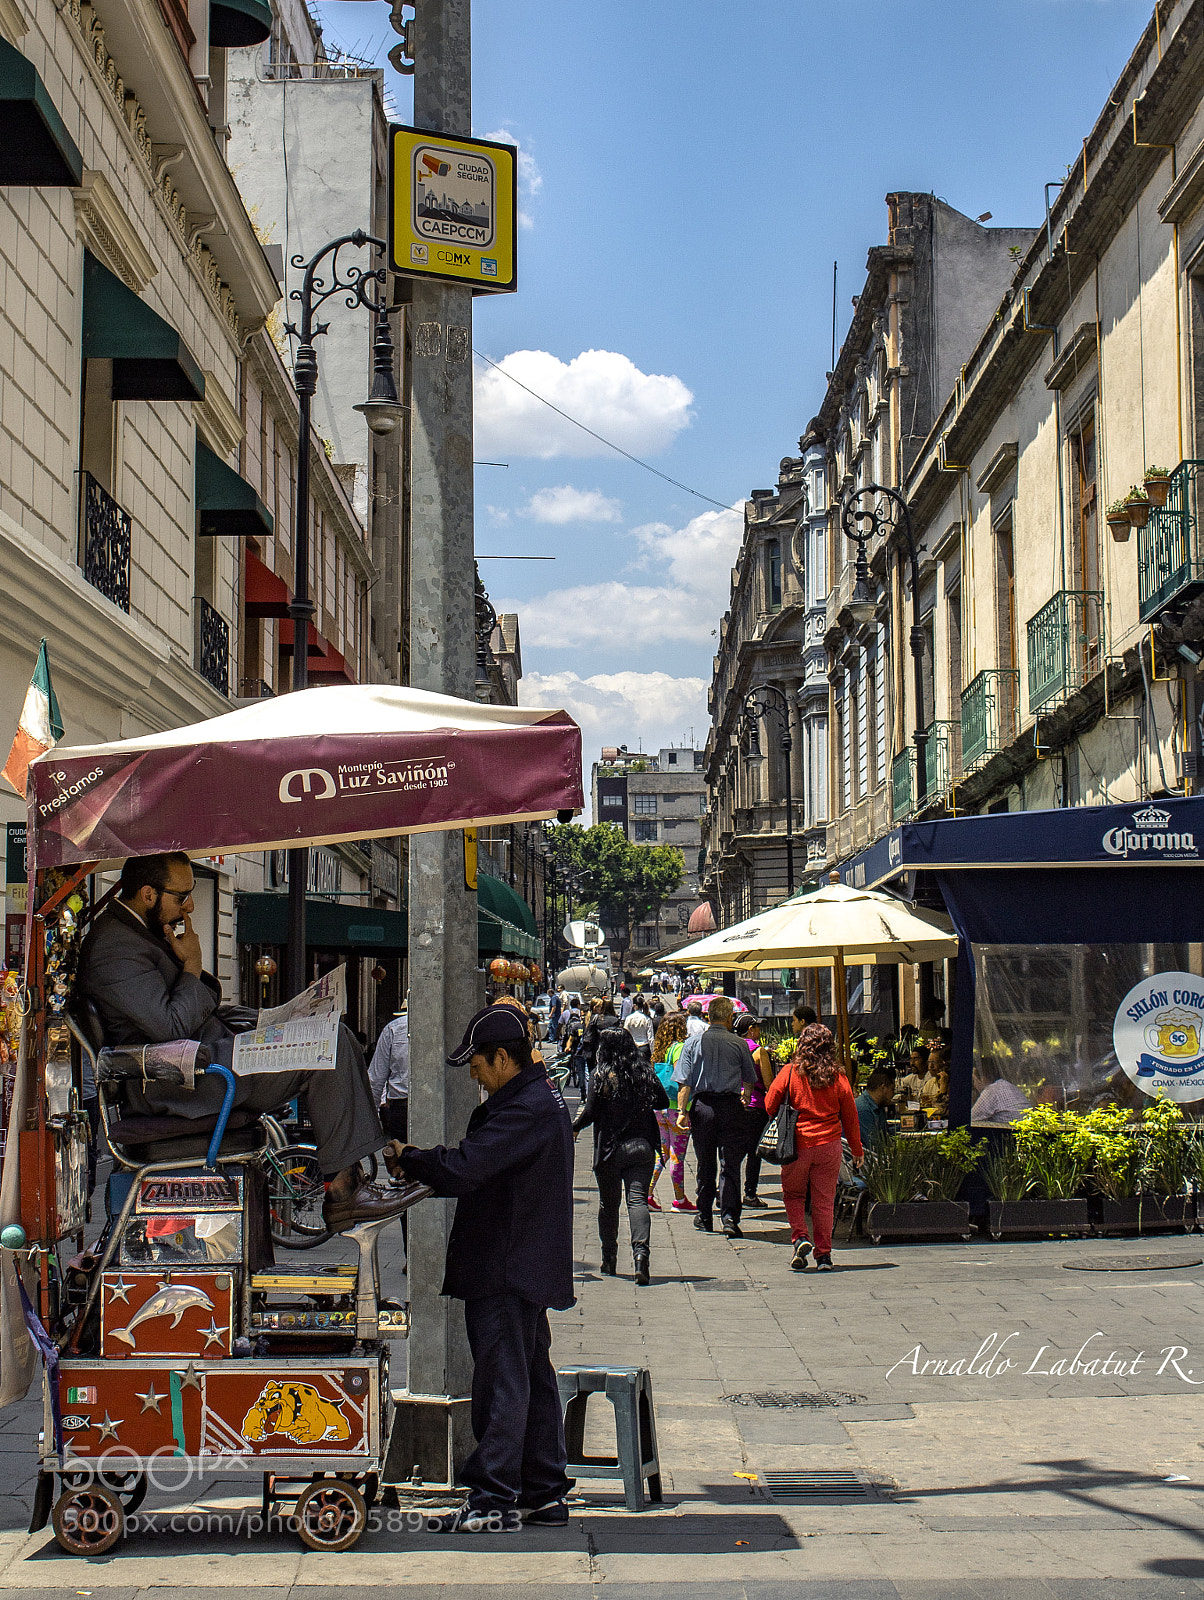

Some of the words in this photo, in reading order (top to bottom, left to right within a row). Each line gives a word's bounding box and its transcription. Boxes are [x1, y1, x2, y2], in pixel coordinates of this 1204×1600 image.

[457, 163, 489, 175] CIUDAD
[456, 171, 490, 184] SEGURA
[422, 220, 486, 241] CAEPCCM
[437, 250, 471, 265] CDMX
[338, 761, 383, 774] Montepío
[49, 770, 67, 784] Te
[339, 773, 371, 789] Luz
[377, 763, 448, 785] Saviñón
[38, 766, 104, 817] Prestamos
[404, 782, 427, 791] desde
[429, 779, 449, 788] 1902
[1102, 826, 1197, 858] Corona
[1126, 989, 1169, 1022] SALÓN
[1172, 1035, 1185, 1043] SC
[1151, 1060, 1183, 1073] FUNDADO
[1152, 1079, 1175, 1087] CDMX
